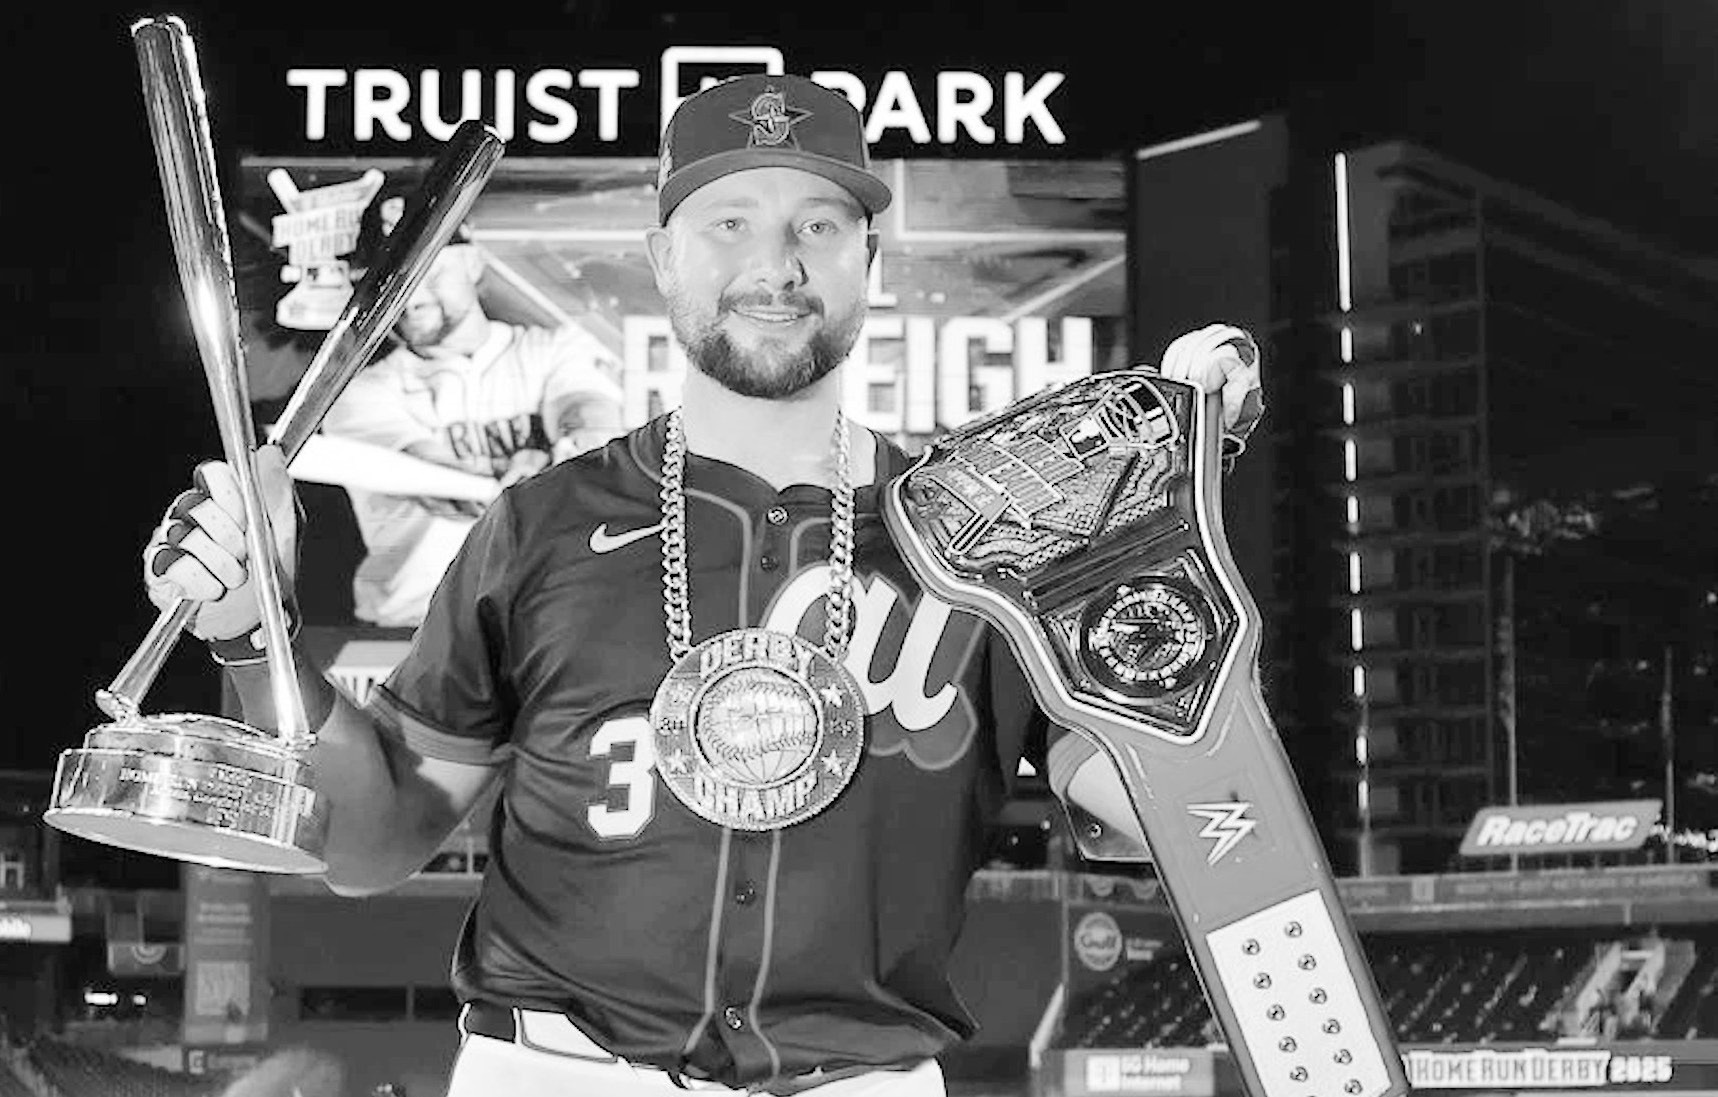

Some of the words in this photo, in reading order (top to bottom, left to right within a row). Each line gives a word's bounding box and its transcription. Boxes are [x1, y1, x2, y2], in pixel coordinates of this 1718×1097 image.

[286, 69, 640, 143] TRUIST
[622, 315, 1094, 434] REIGH
[700, 633, 816, 683] DERBY
[693, 769, 818, 822] CHAMP
[1476, 811, 1638, 847] RaceTrac
[1609, 1055, 1674, 1083] 2025
